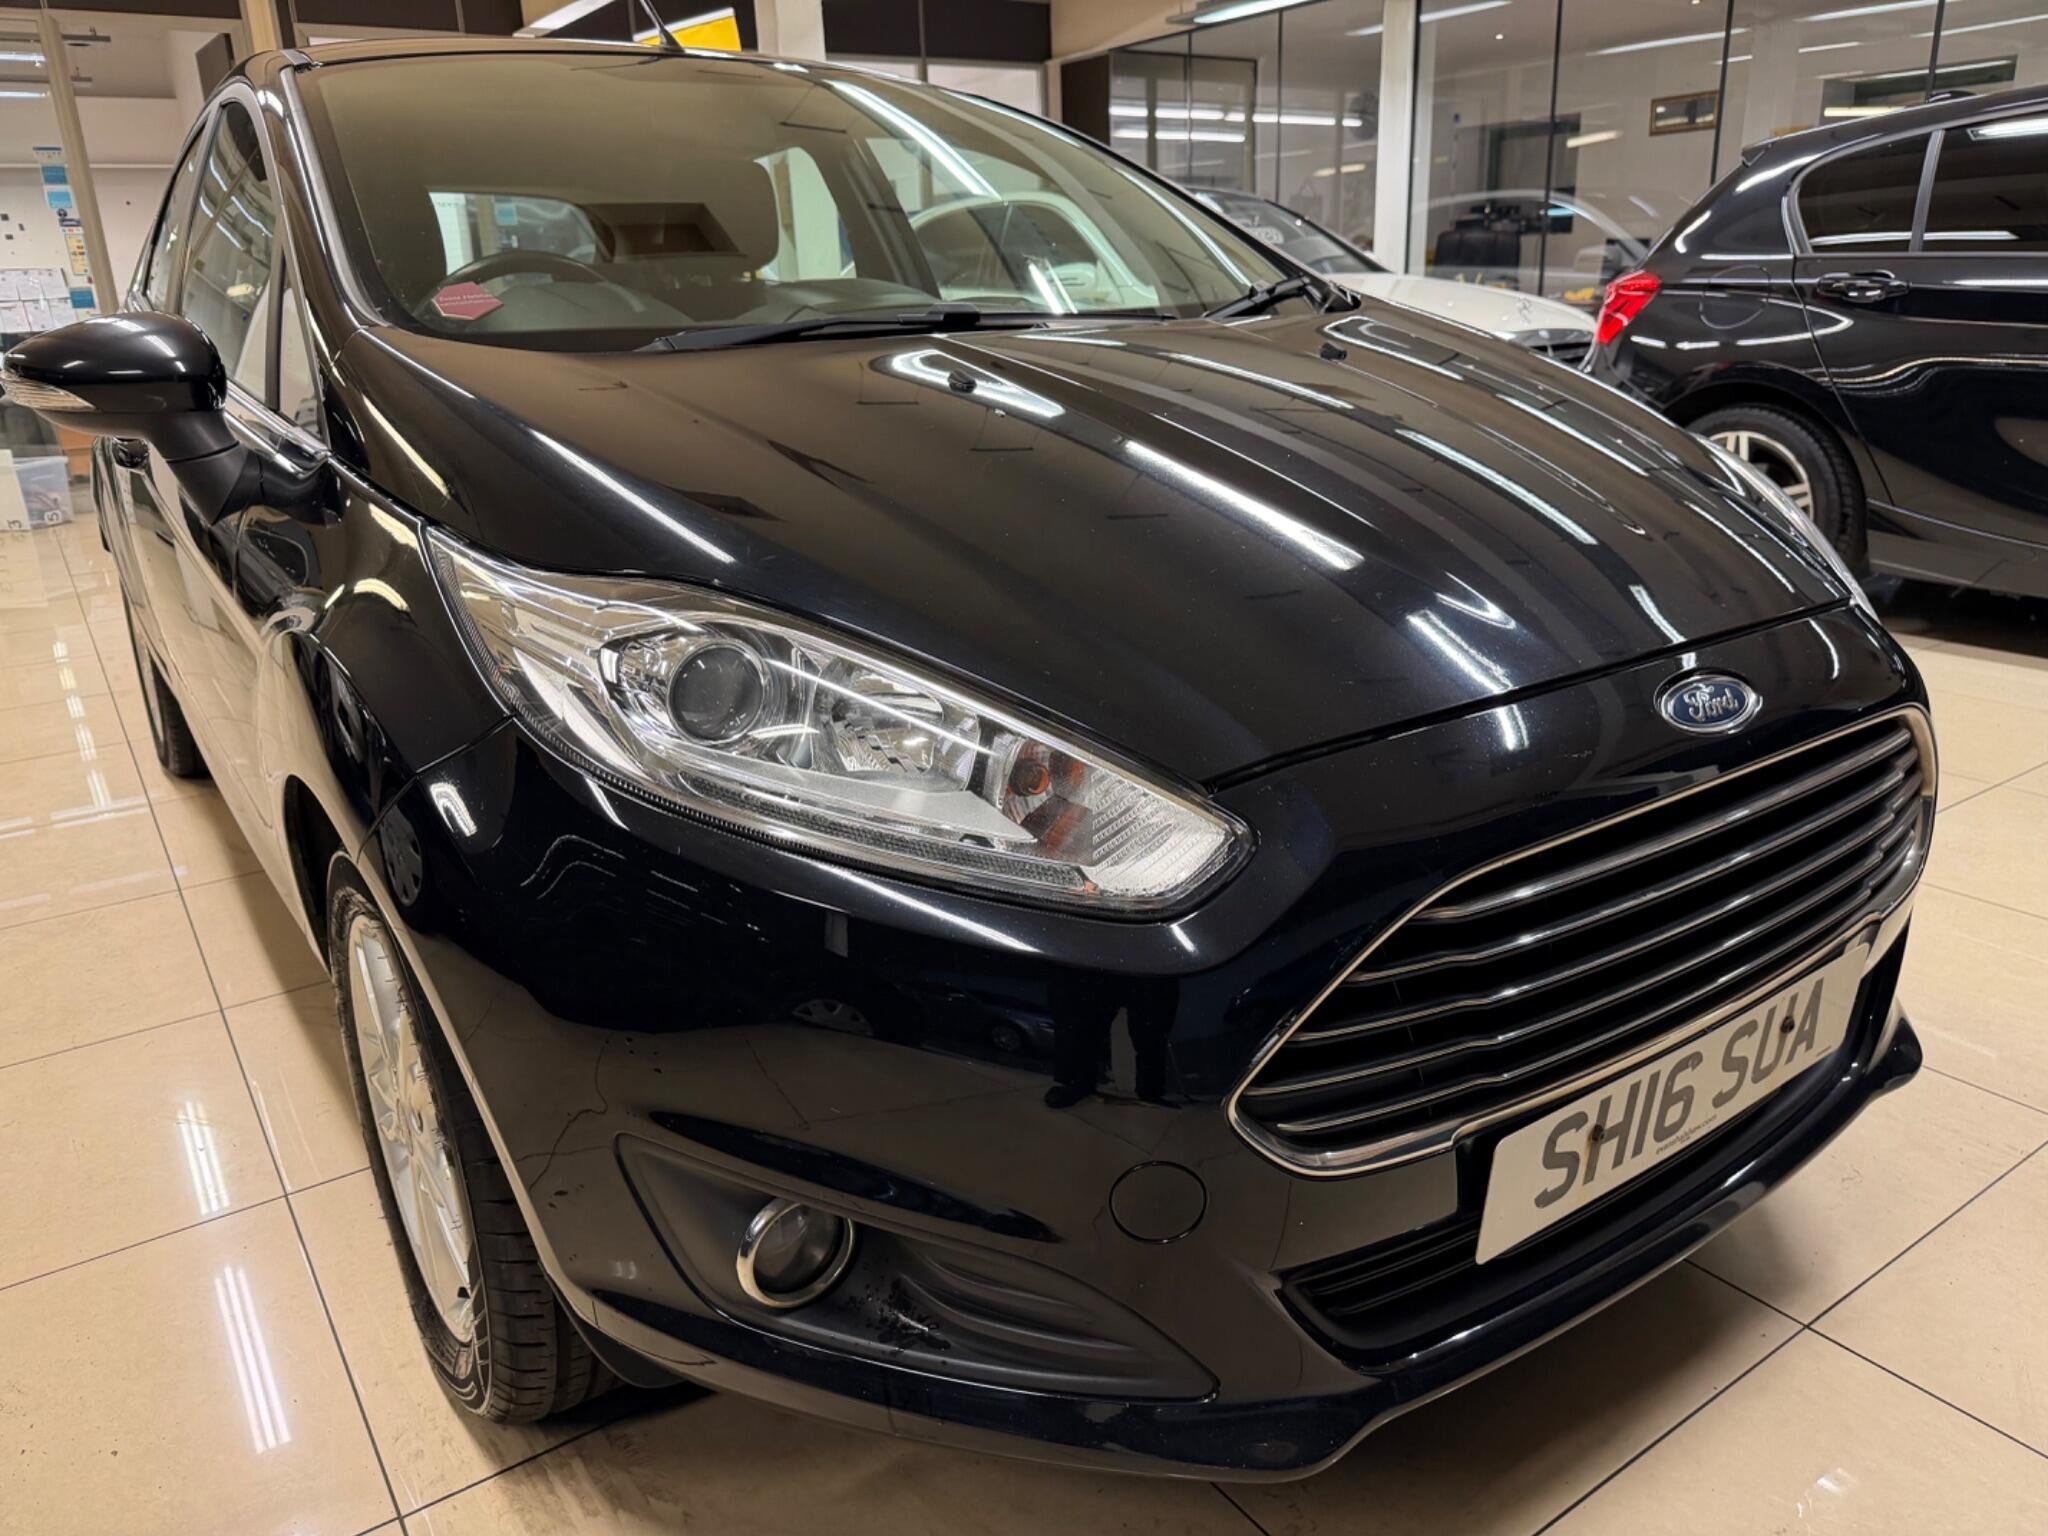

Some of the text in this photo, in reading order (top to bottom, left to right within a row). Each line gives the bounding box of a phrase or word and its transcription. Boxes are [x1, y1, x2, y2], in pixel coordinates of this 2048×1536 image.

[1683, 683, 1739, 722] Ford
[1533, 976, 1825, 1209] SH16 SUA
